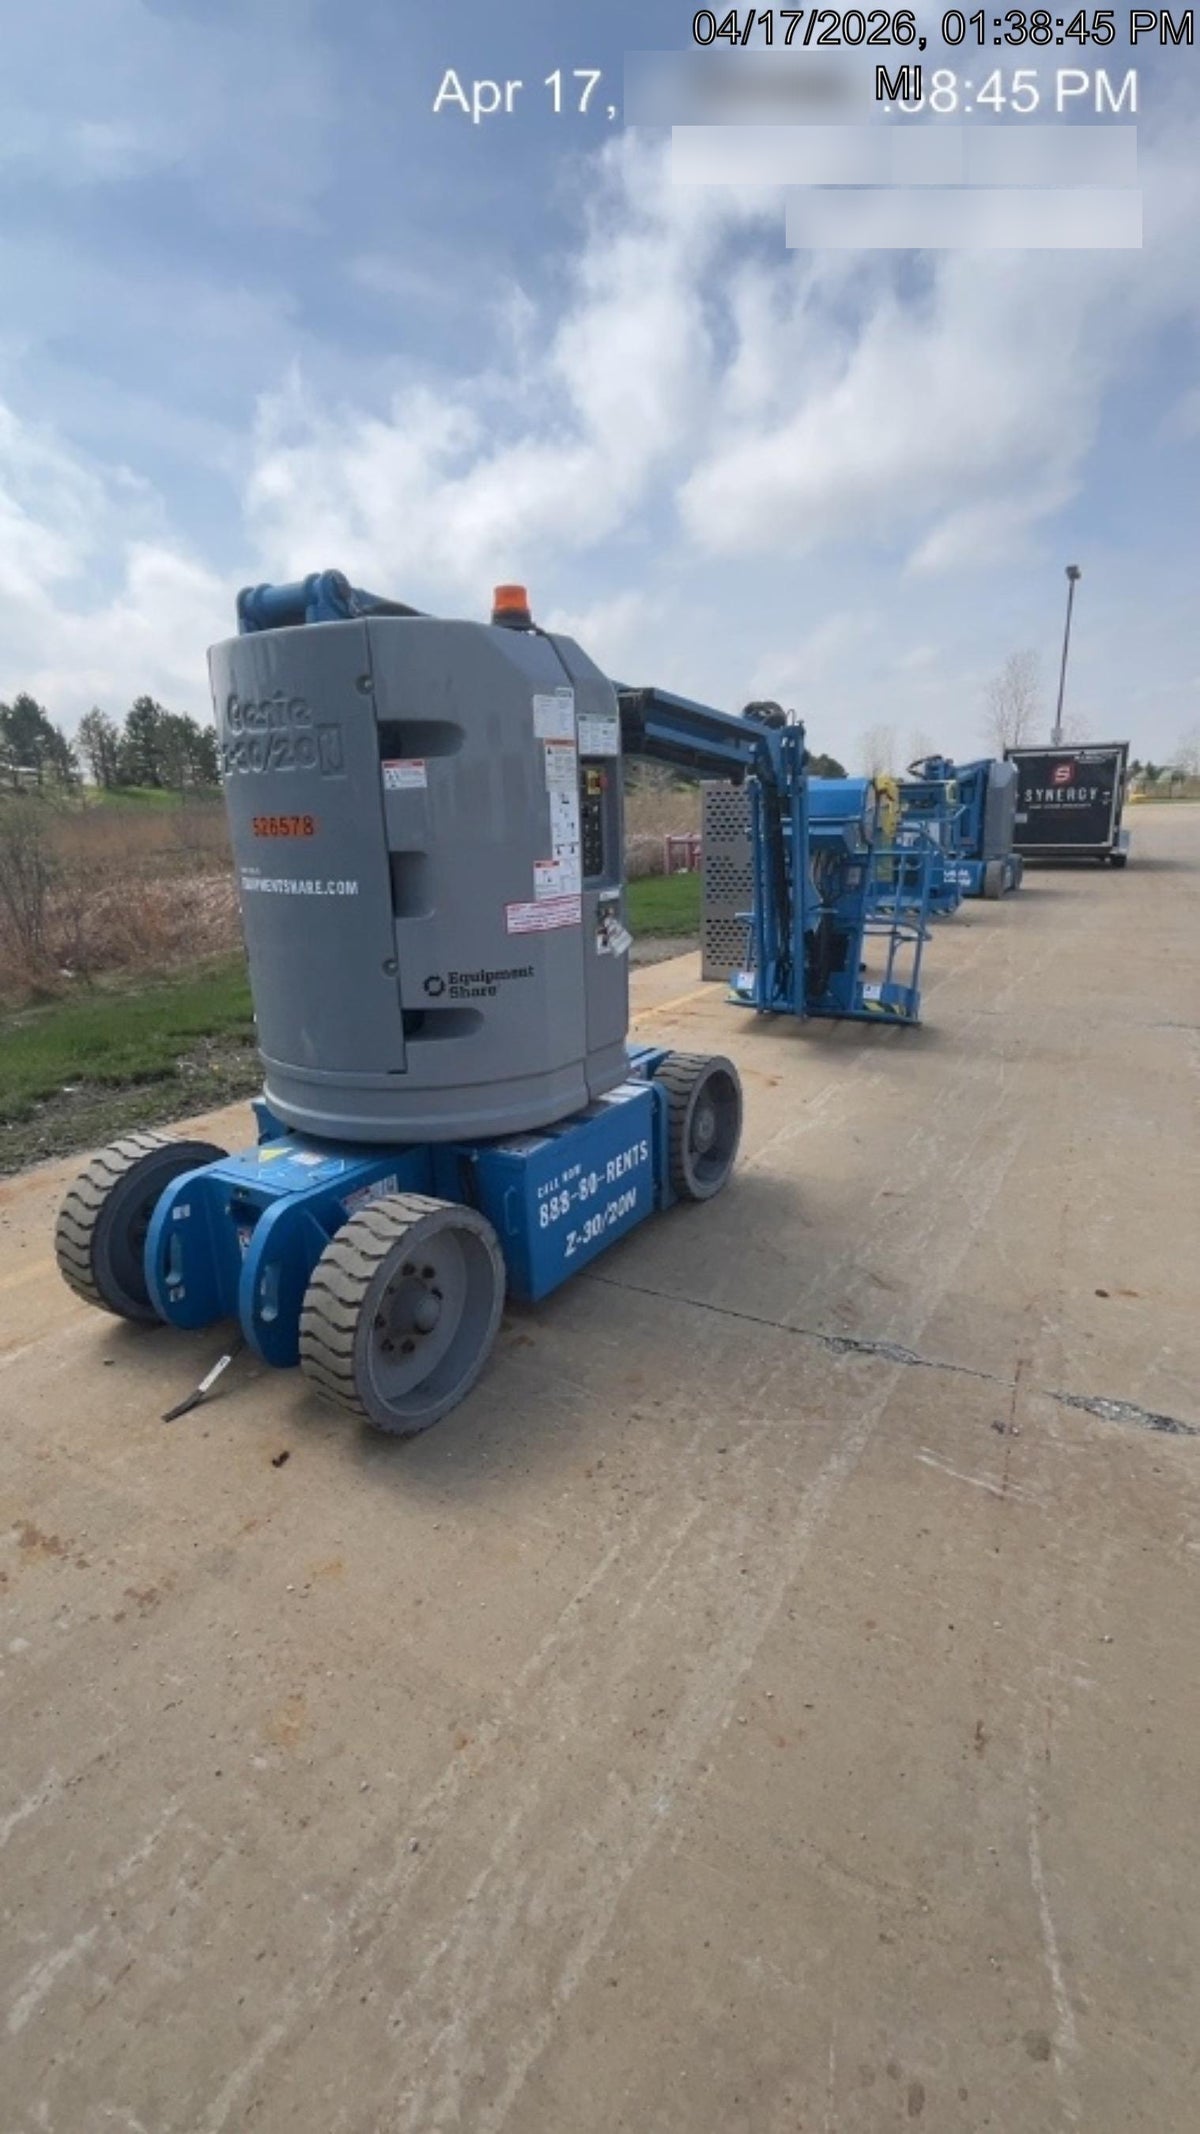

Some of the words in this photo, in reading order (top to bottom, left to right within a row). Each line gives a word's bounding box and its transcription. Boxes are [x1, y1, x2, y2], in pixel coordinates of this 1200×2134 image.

[1024, 786, 1098, 802] SYNERGY
[252, 814, 315, 837] 526578
[447, 965, 535, 986] Equipment
[449, 986, 497, 999] Share
[537, 1178, 560, 1199] CALL
[561, 1163, 583, 1183] NOW
[538, 1139, 649, 1229] 888-80-RENTS
[563, 1186, 638, 1258] Z-30/20N
